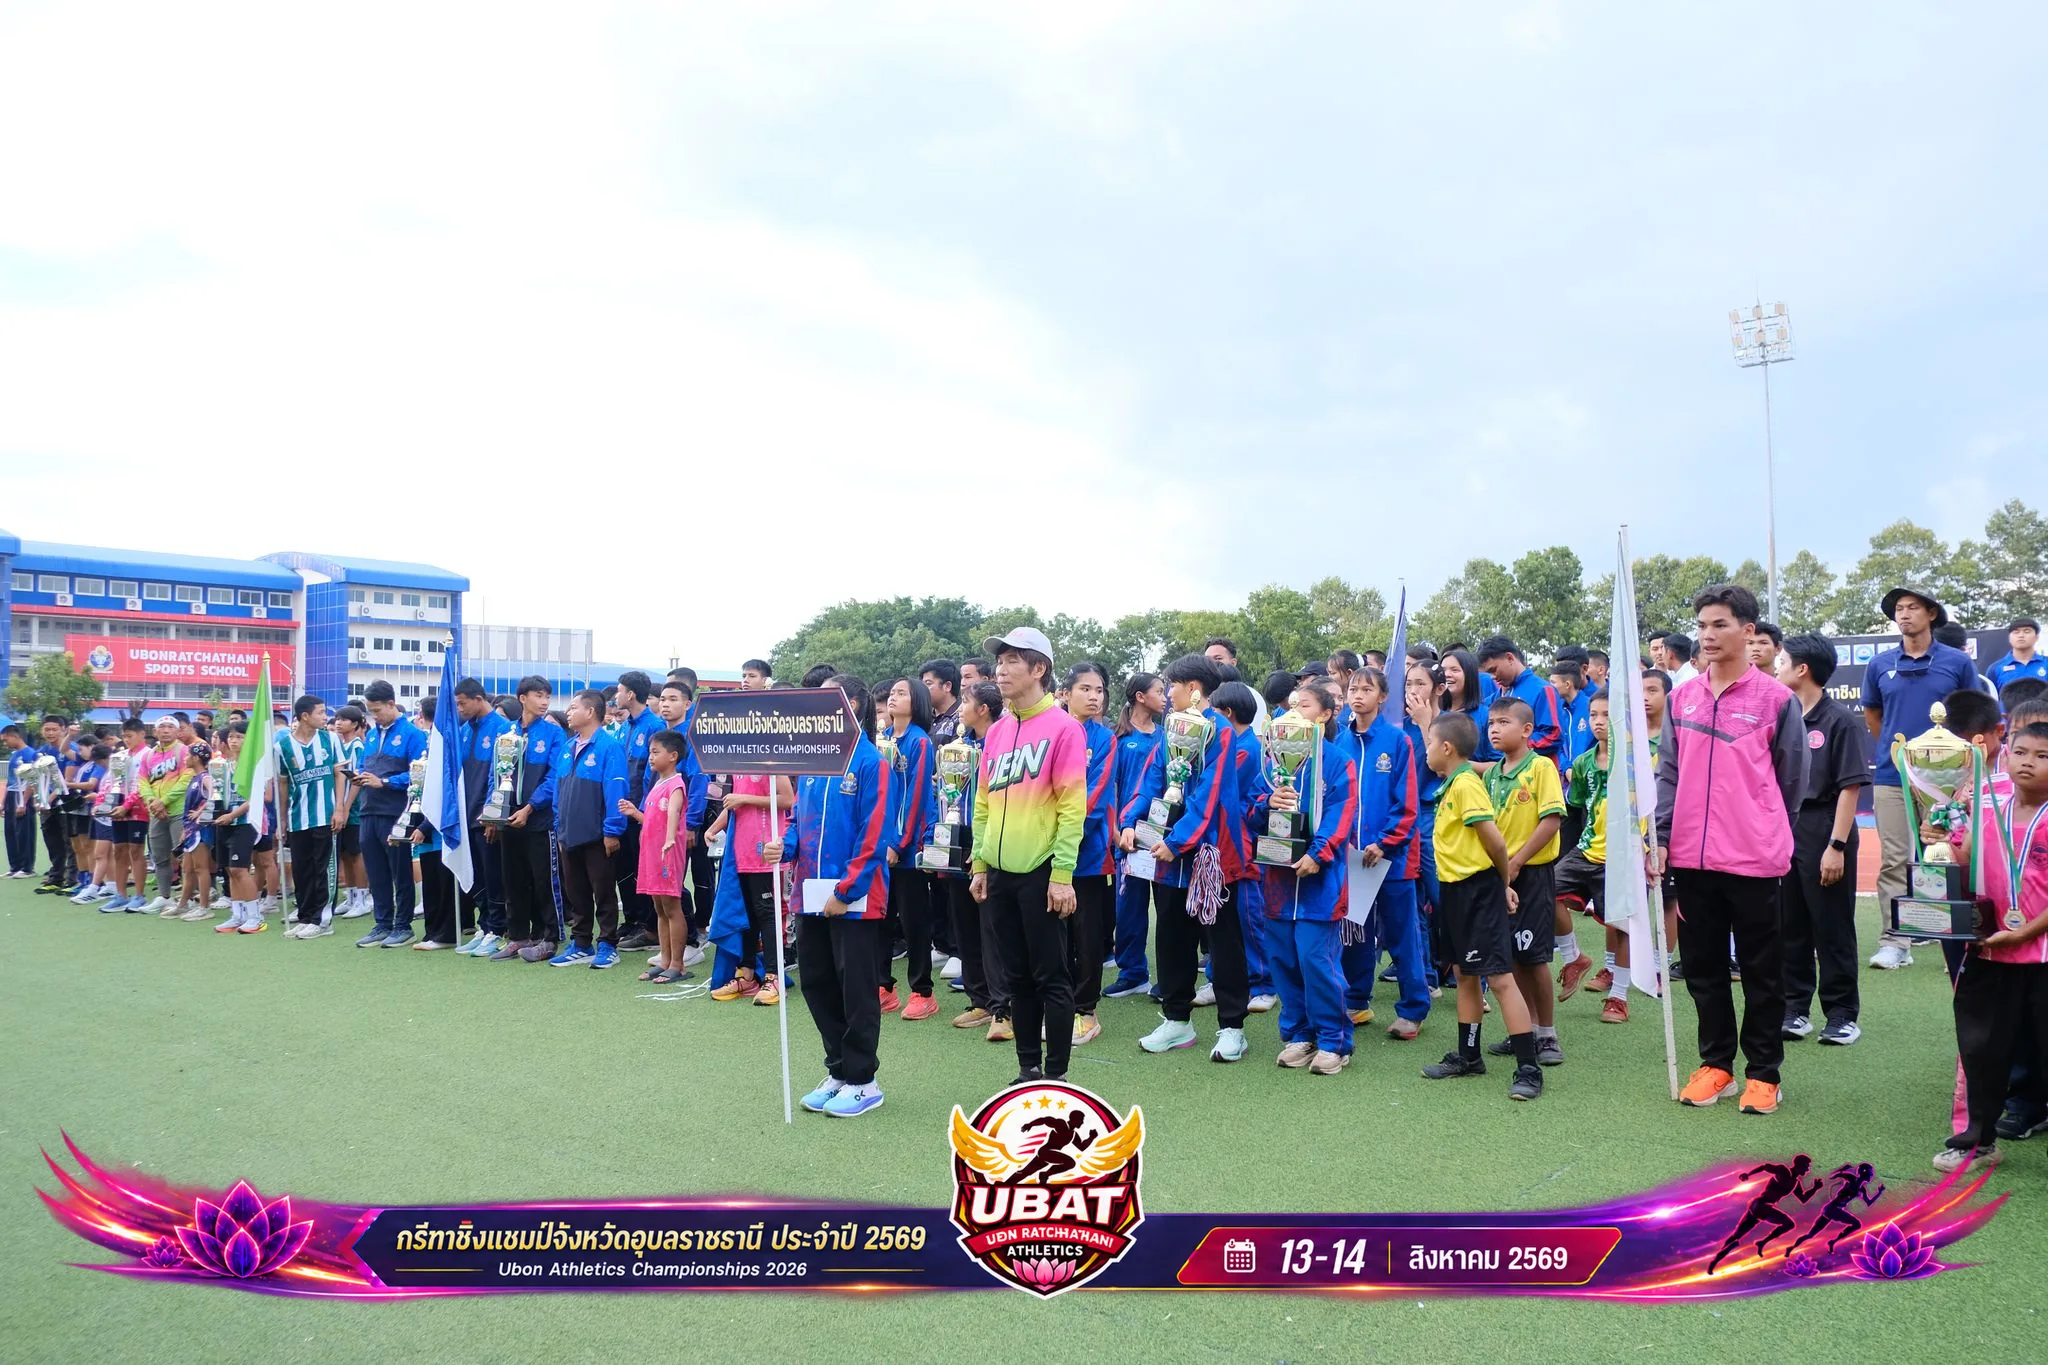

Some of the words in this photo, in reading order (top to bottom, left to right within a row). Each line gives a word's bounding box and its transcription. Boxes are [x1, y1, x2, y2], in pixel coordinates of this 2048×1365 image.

[129, 649, 259, 664] UBONRATCHATHANI
[144, 663, 195, 675] SPORTS
[201, 665, 249, 677] SCHOOL
[702, 744, 725, 754] UBON
[727, 744, 771, 754] ATHLETICS
[773, 744, 841, 754] CHAMPIONSHIPS
[1514, 929, 1534, 952] 19
